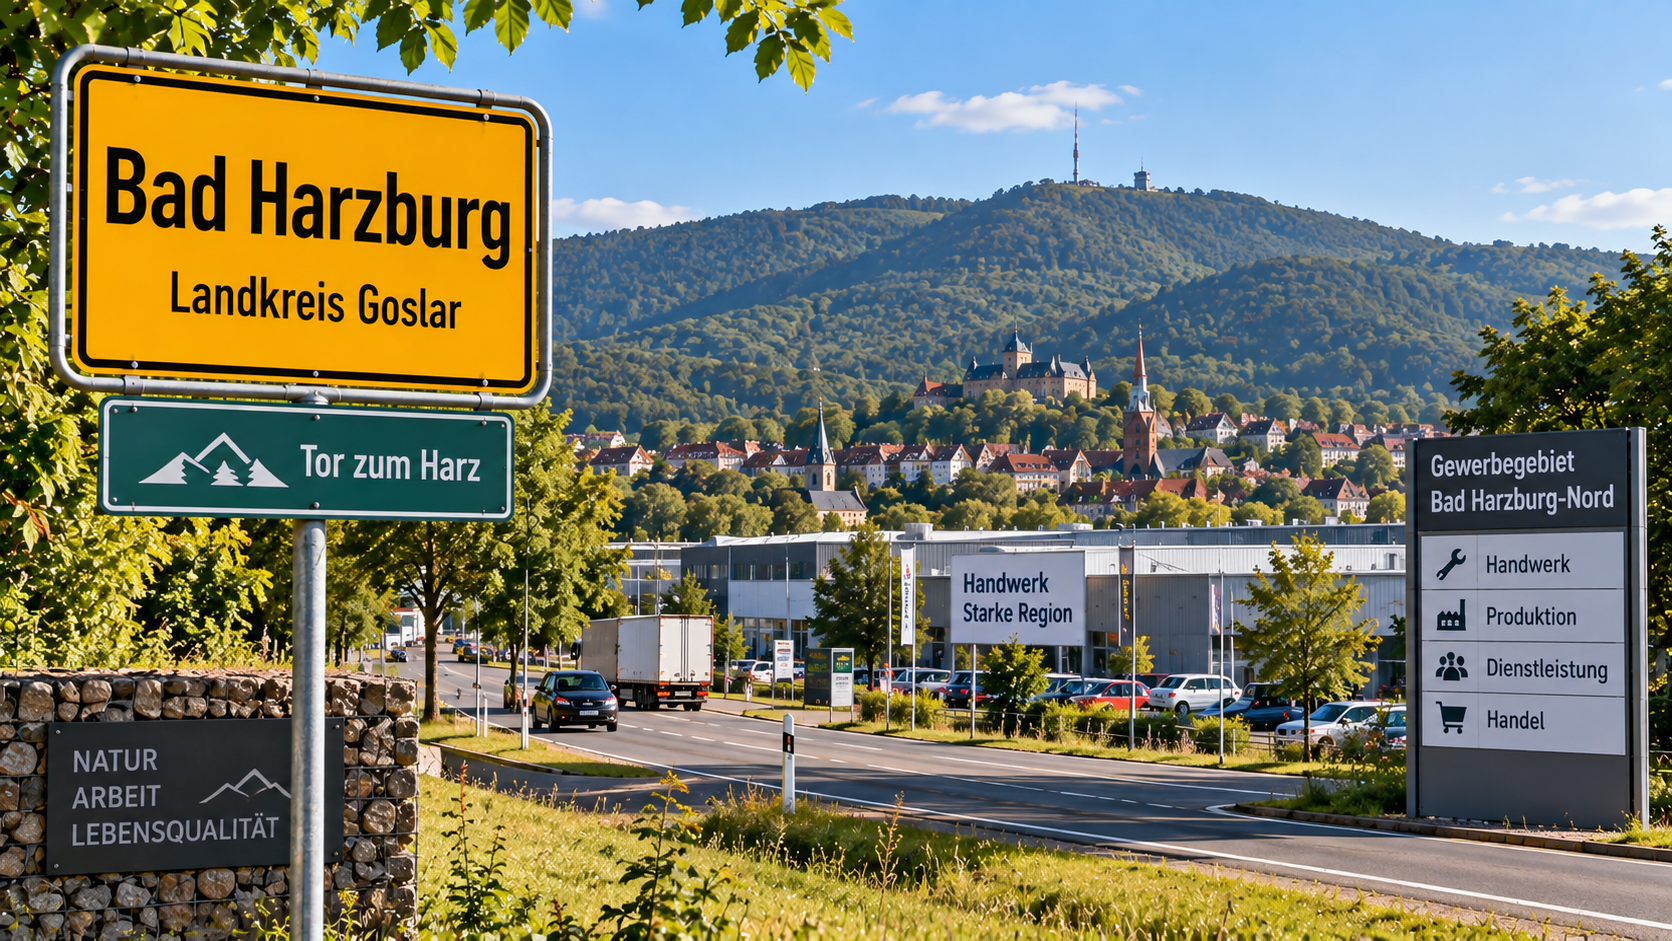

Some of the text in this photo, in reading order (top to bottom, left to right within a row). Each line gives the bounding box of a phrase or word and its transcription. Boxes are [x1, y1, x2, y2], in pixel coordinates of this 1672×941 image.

[106, 146, 511, 270] Bad Harzburg
[171, 270, 462, 330] Landkreis Goslar
[300, 444, 481, 482] Tor zum Harz
[1431, 449, 1575, 480] Gewerbegebiet
[1431, 483, 1614, 516] Bad Harzburg-Nord
[1486, 553, 1571, 574] Handwerk
[963, 571, 1049, 594] Handwerk
[963, 601, 1073, 629] Starke Region
[1486, 606, 1577, 626] Produktion
[1487, 657, 1608, 684] Dienstleistung
[1487, 709, 1545, 730] Handel
[73, 748, 158, 773] NATUR
[72, 784, 161, 810] ARBEIT
[72, 812, 280, 847] LEBENSQUALITÄT
